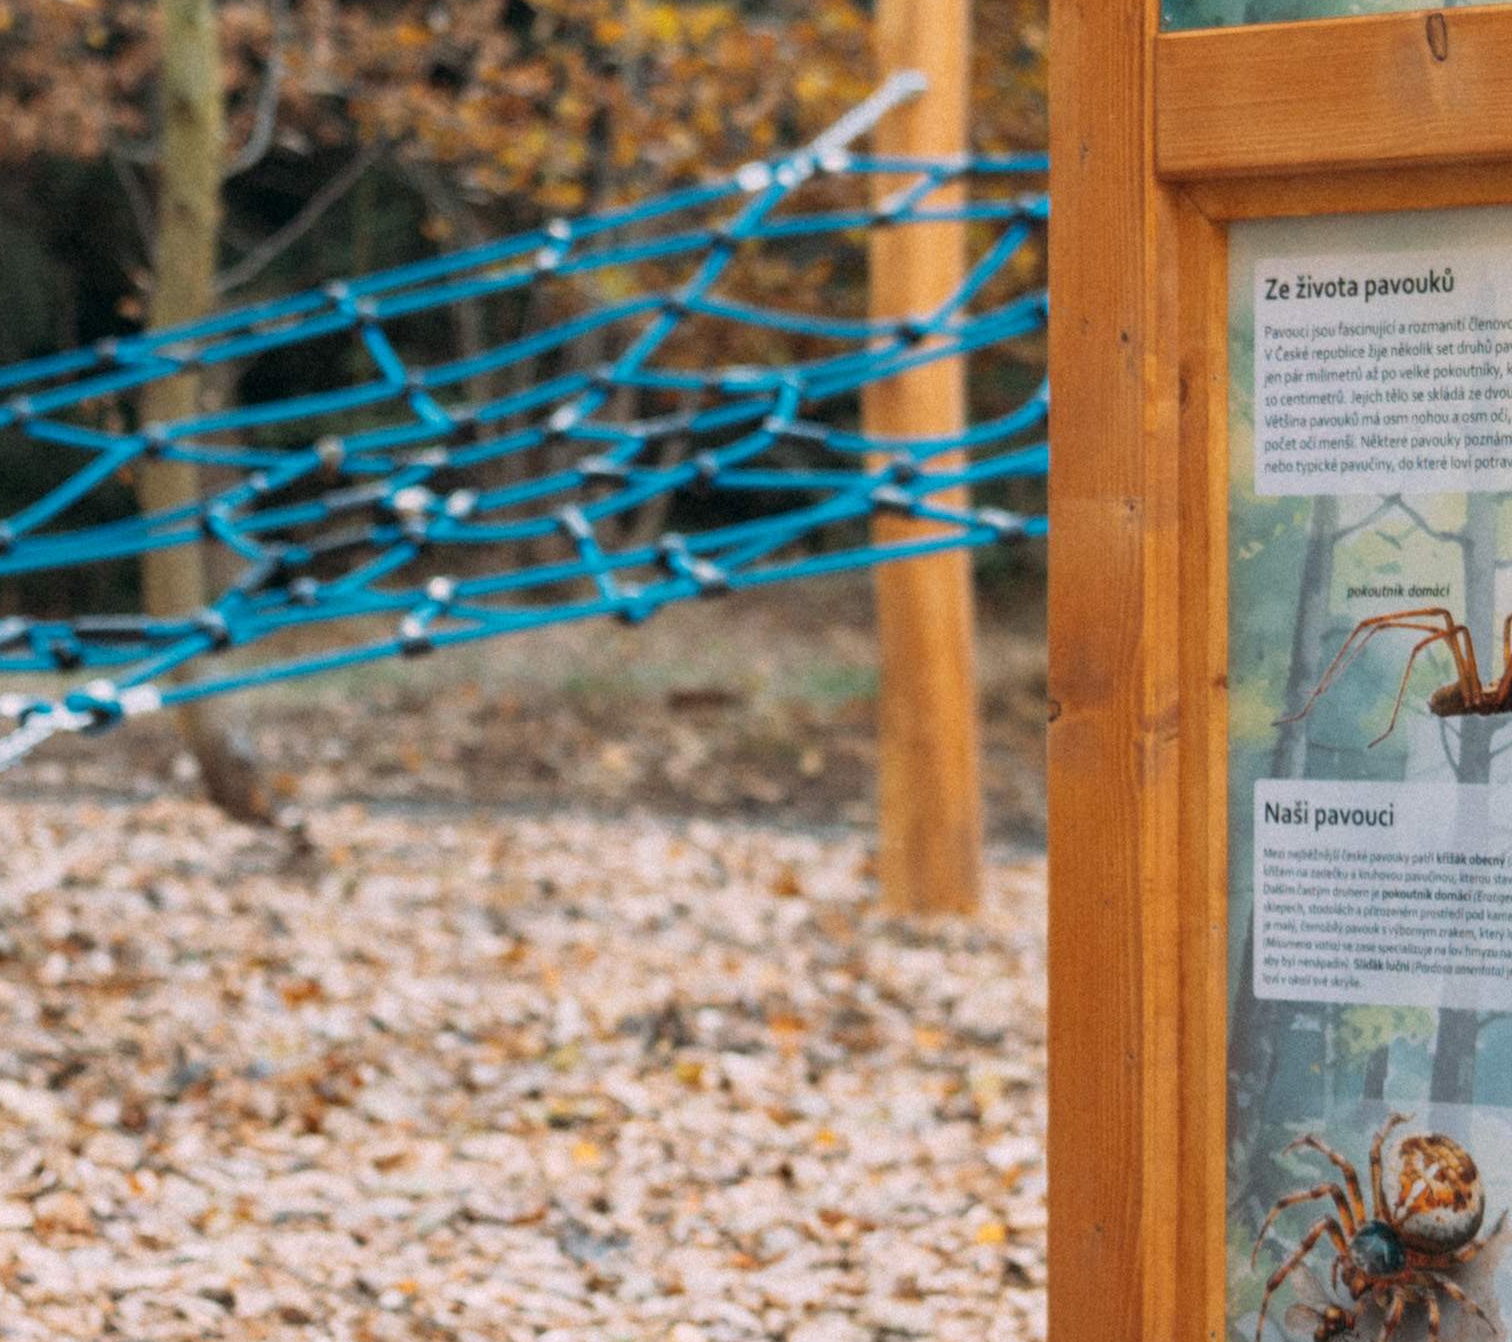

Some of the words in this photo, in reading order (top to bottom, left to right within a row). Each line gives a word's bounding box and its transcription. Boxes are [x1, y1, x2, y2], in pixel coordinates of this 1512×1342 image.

[1265, 278, 1290, 300] Ze
[1296, 275, 1358, 299] života
[1364, 268, 1455, 302] pavouků
[1264, 323, 1310, 338] Pavouci
[1311, 322, 1336, 341] jsou
[1274, 344, 1309, 360] České
[1368, 341, 1388, 361] žije
[1390, 340, 1433, 357] několik
[1436, 340, 1454, 355] set
[1456, 338, 1493, 354] druhů
[1347, 583, 1403, 599] pokoutník
[1408, 583, 1450, 597] domácí
[1264, 802, 1309, 825] Naši
[1315, 803, 1395, 830] pavouci
